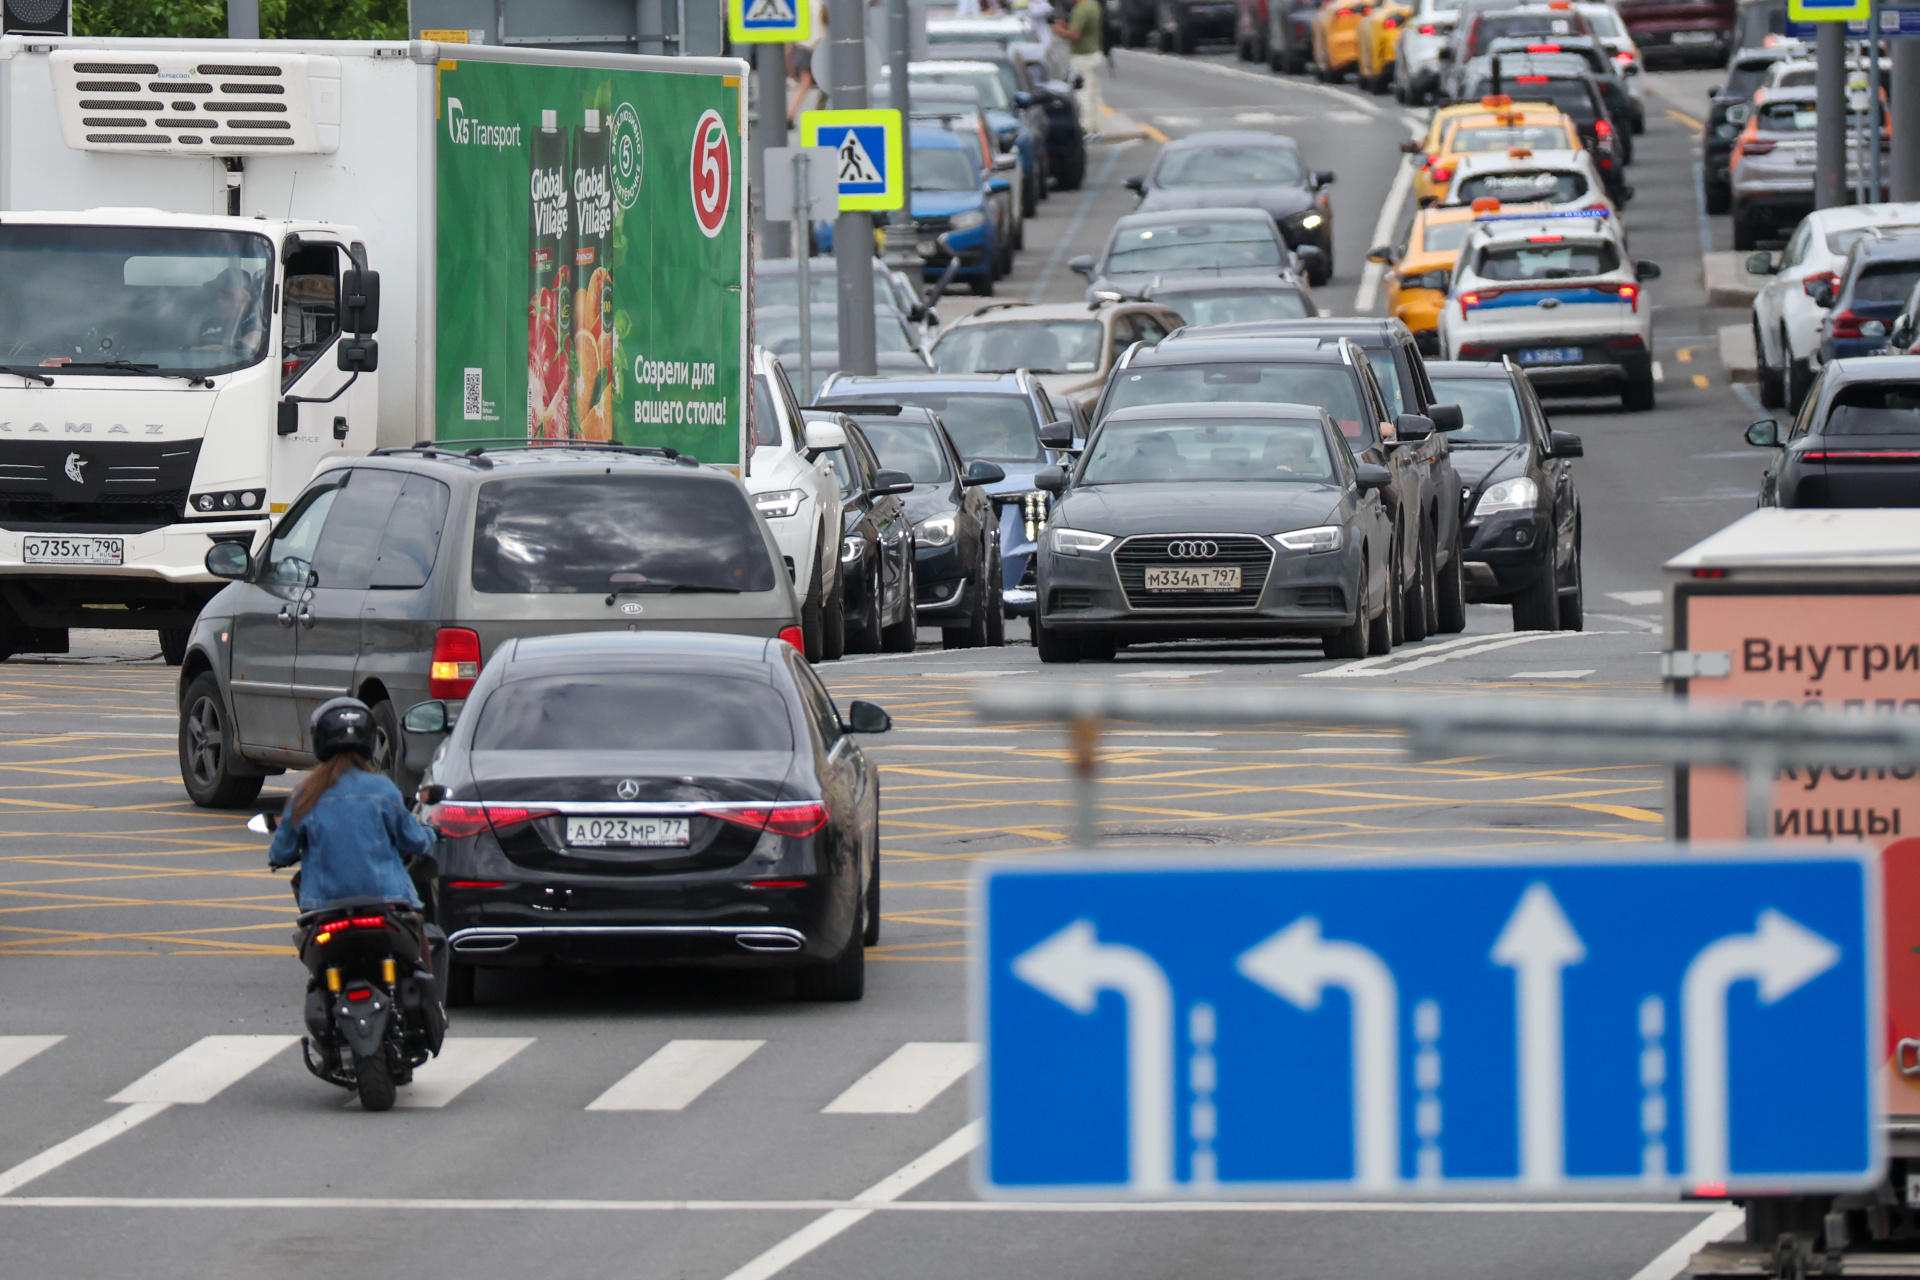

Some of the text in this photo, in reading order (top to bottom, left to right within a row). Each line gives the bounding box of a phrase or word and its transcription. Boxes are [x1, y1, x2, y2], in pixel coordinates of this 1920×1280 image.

[471, 119, 521, 152] Transport
[612, 109, 641, 155] ЭКСКЛЮЗИВНО
[531, 165, 567, 201] Global
[574, 165, 610, 201] Global
[614, 163, 641, 201] ПЯТЁРОЧКЕ
[533, 201, 568, 239] Village
[576, 201, 611, 239] Village
[635, 355, 715, 392] Созрели для
[635, 396, 726, 425] вашего стола!
[95, 541, 118, 553] 790
[1213, 570, 1236, 582] 797
[1743, 637, 1920, 681] Внутри
[662, 820, 682, 834] 77
[1758, 808, 1900, 843] иццы
